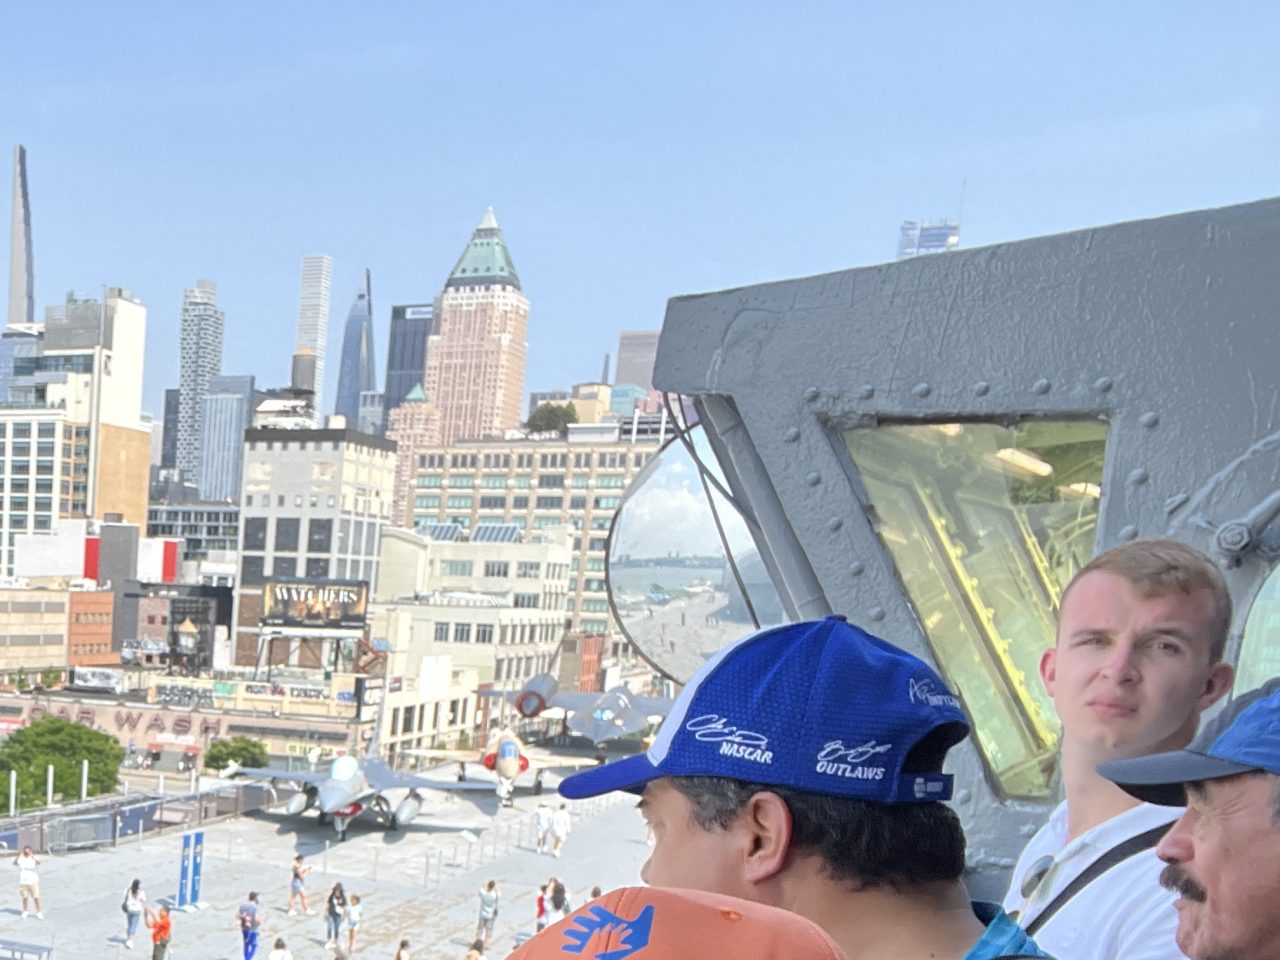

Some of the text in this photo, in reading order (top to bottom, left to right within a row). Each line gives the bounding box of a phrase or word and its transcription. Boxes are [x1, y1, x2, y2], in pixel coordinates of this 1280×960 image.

[29, 703, 96, 728] CAR
[115, 709, 222, 735] WASH
[719, 741, 774, 764] NASCAR
[816, 760, 886, 781] OUTLAWS
